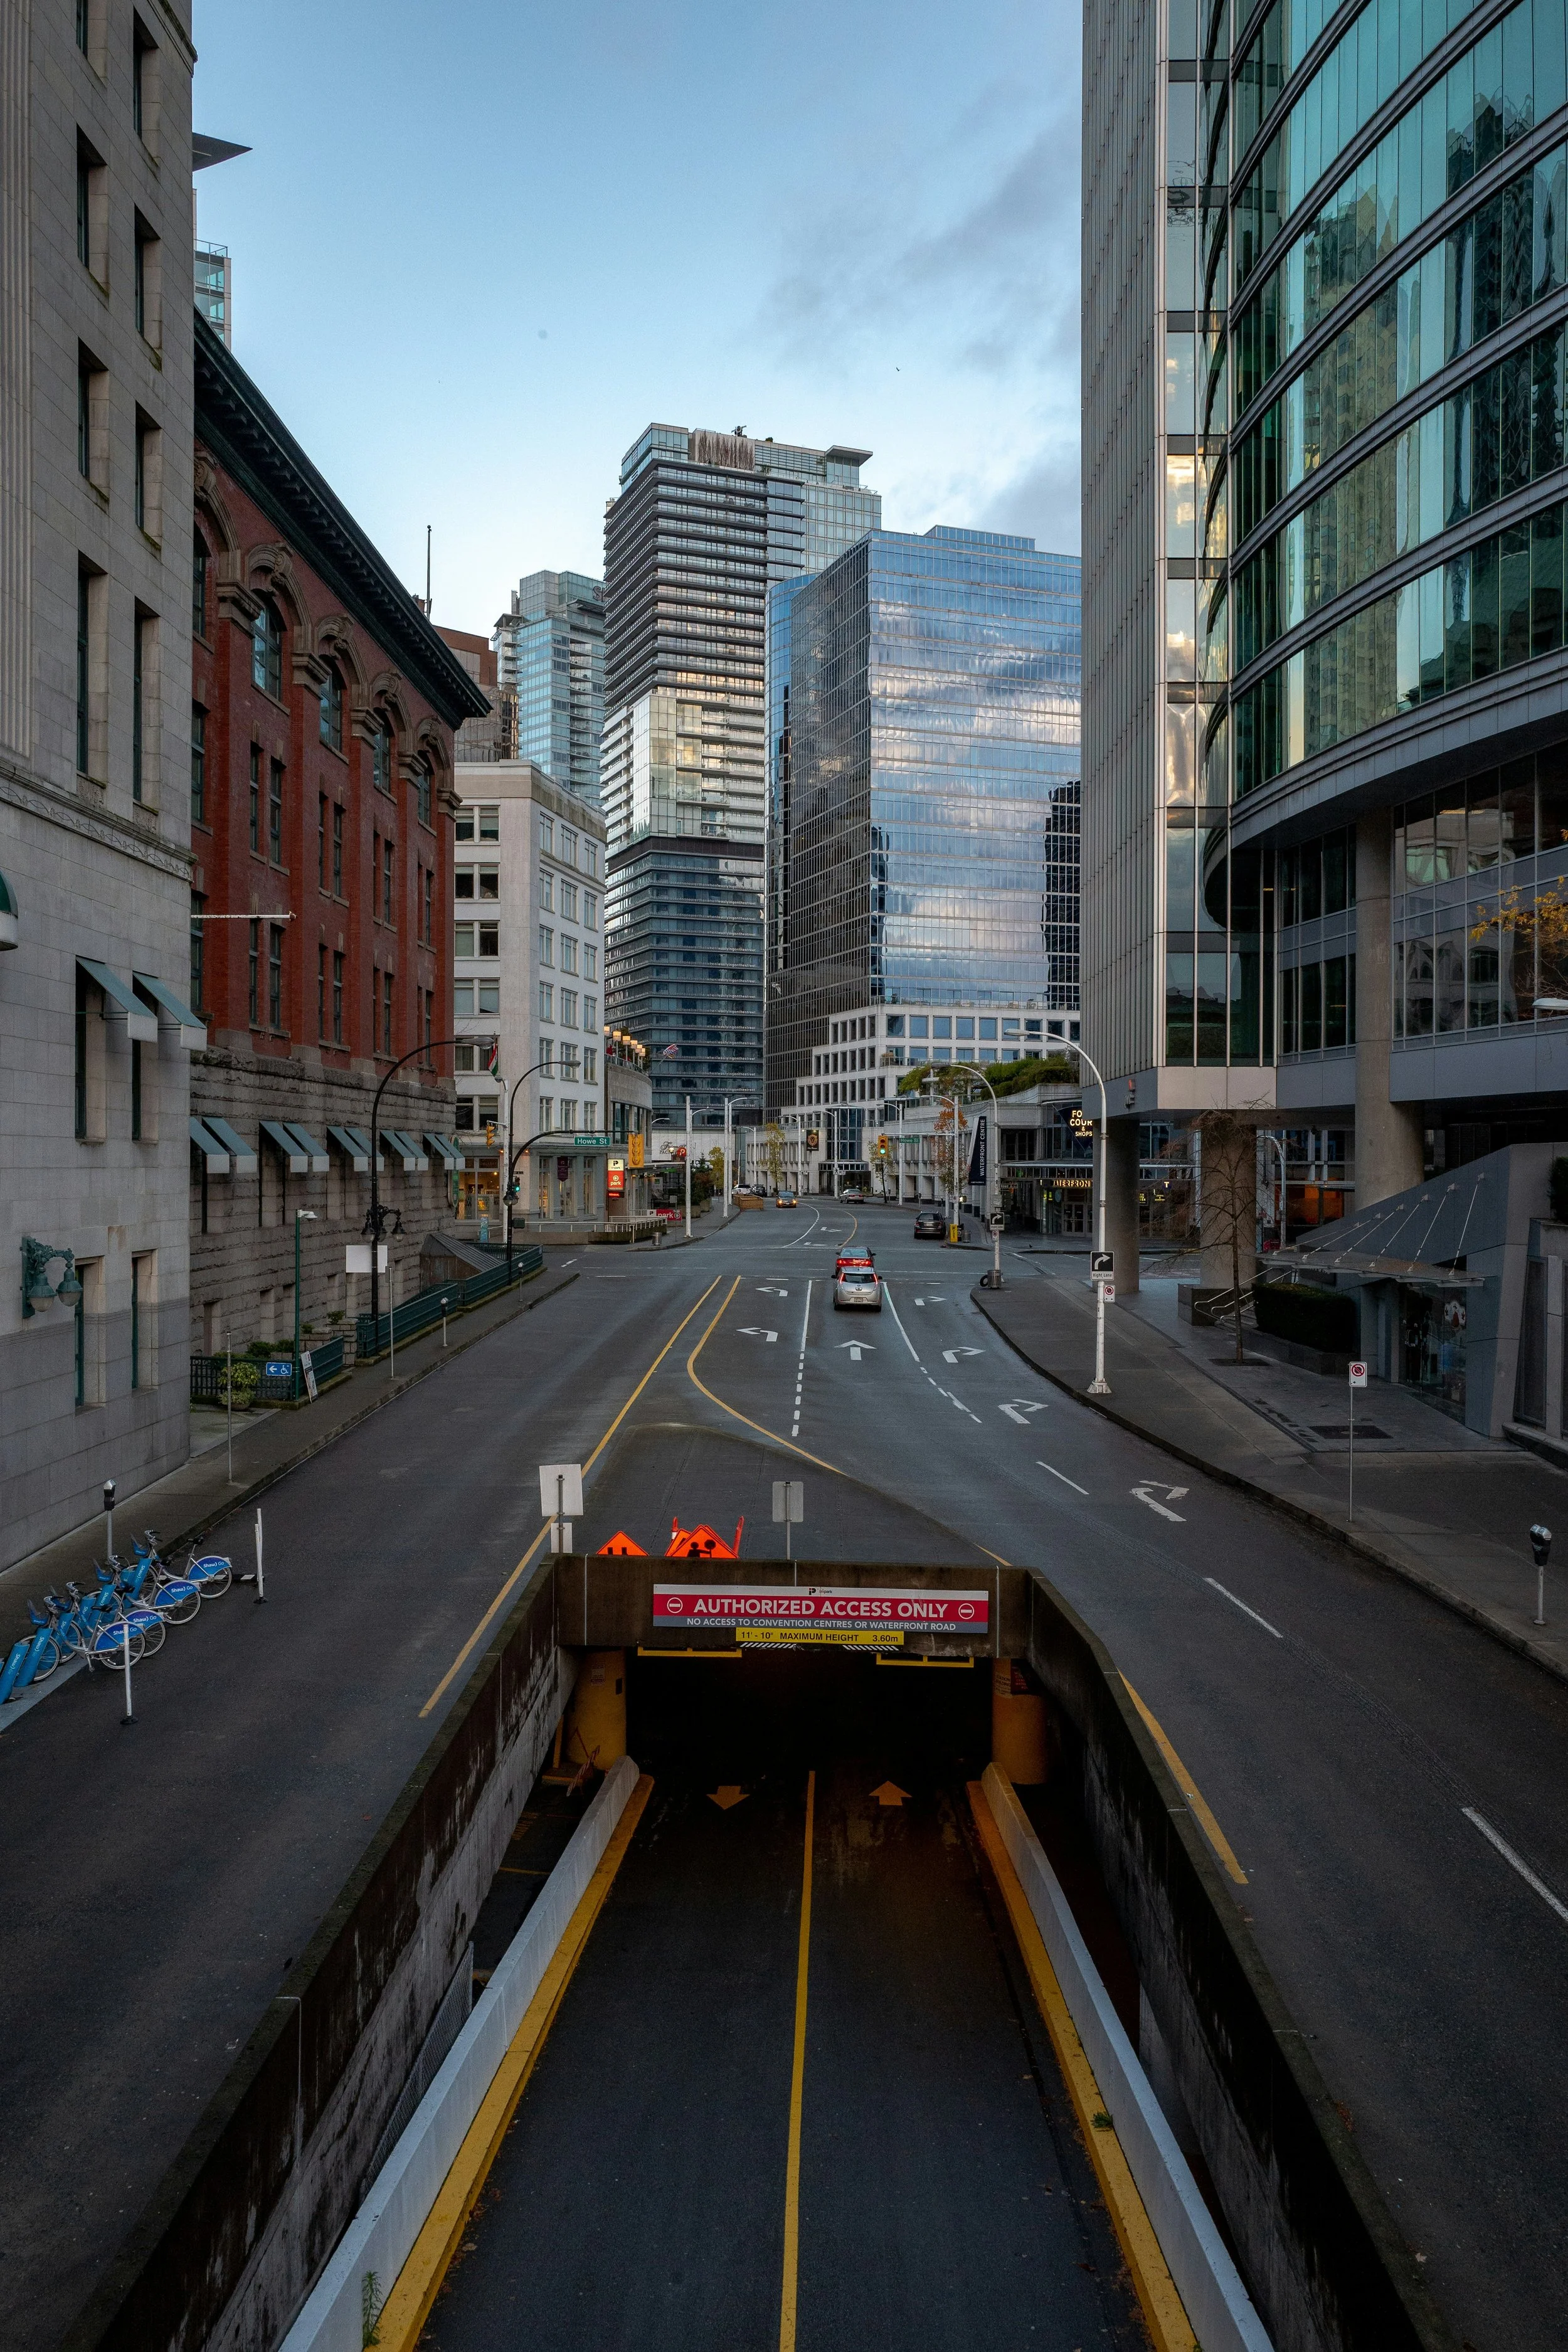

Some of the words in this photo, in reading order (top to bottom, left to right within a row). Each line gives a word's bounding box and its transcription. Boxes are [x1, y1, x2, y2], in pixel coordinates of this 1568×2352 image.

[1069, 1118, 1093, 1126] COUR
[693, 1599, 815, 1615] AUTHORIZED
[820, 1601, 892, 1617] ACCESS
[898, 1602, 948, 1618] ONLY
[752, 1619, 812, 1628] CONVENTION
[813, 1620, 852, 1629] CENTRES
[869, 1621, 929, 1630] WATERFRONT
[930, 1623, 956, 1631] ROAD
[780, 1633, 822, 1641] MAXIMUM
